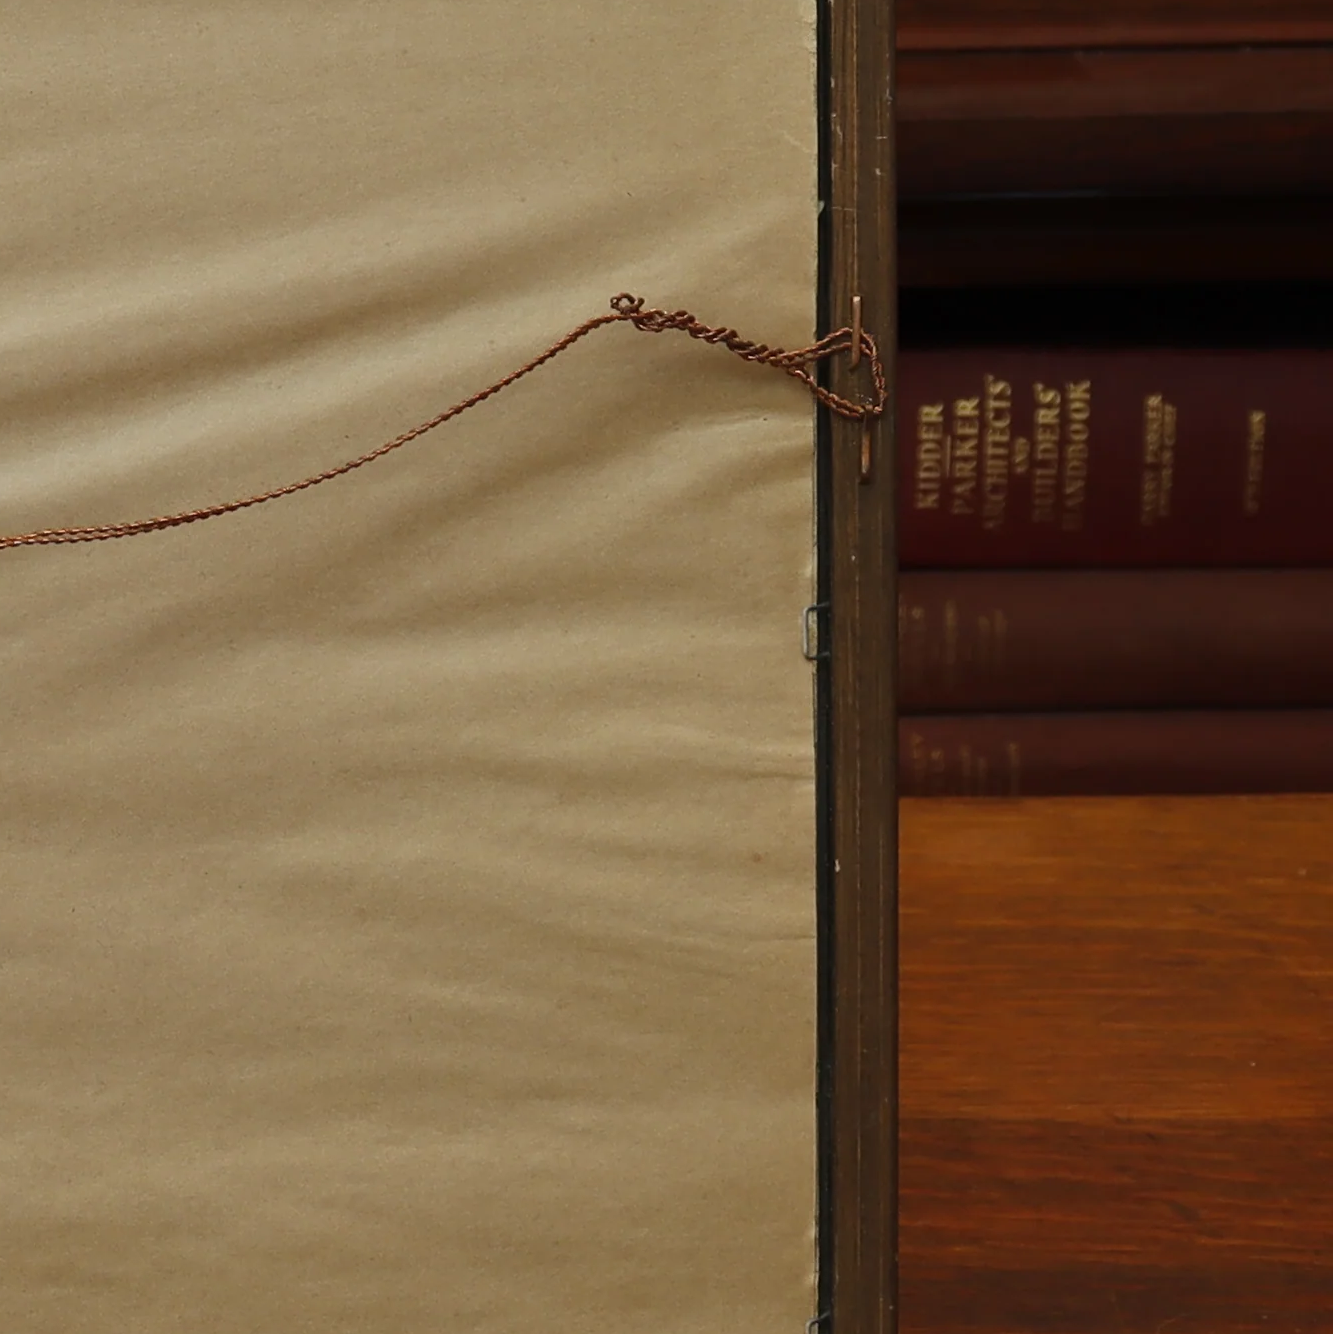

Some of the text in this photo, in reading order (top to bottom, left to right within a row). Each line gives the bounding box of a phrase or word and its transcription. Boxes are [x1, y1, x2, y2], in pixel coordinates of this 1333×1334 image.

[914, 402, 945, 510] KIDDER
[950, 395, 981, 515] PARKER
[1062, 379, 1092, 532] HANDBOOK
